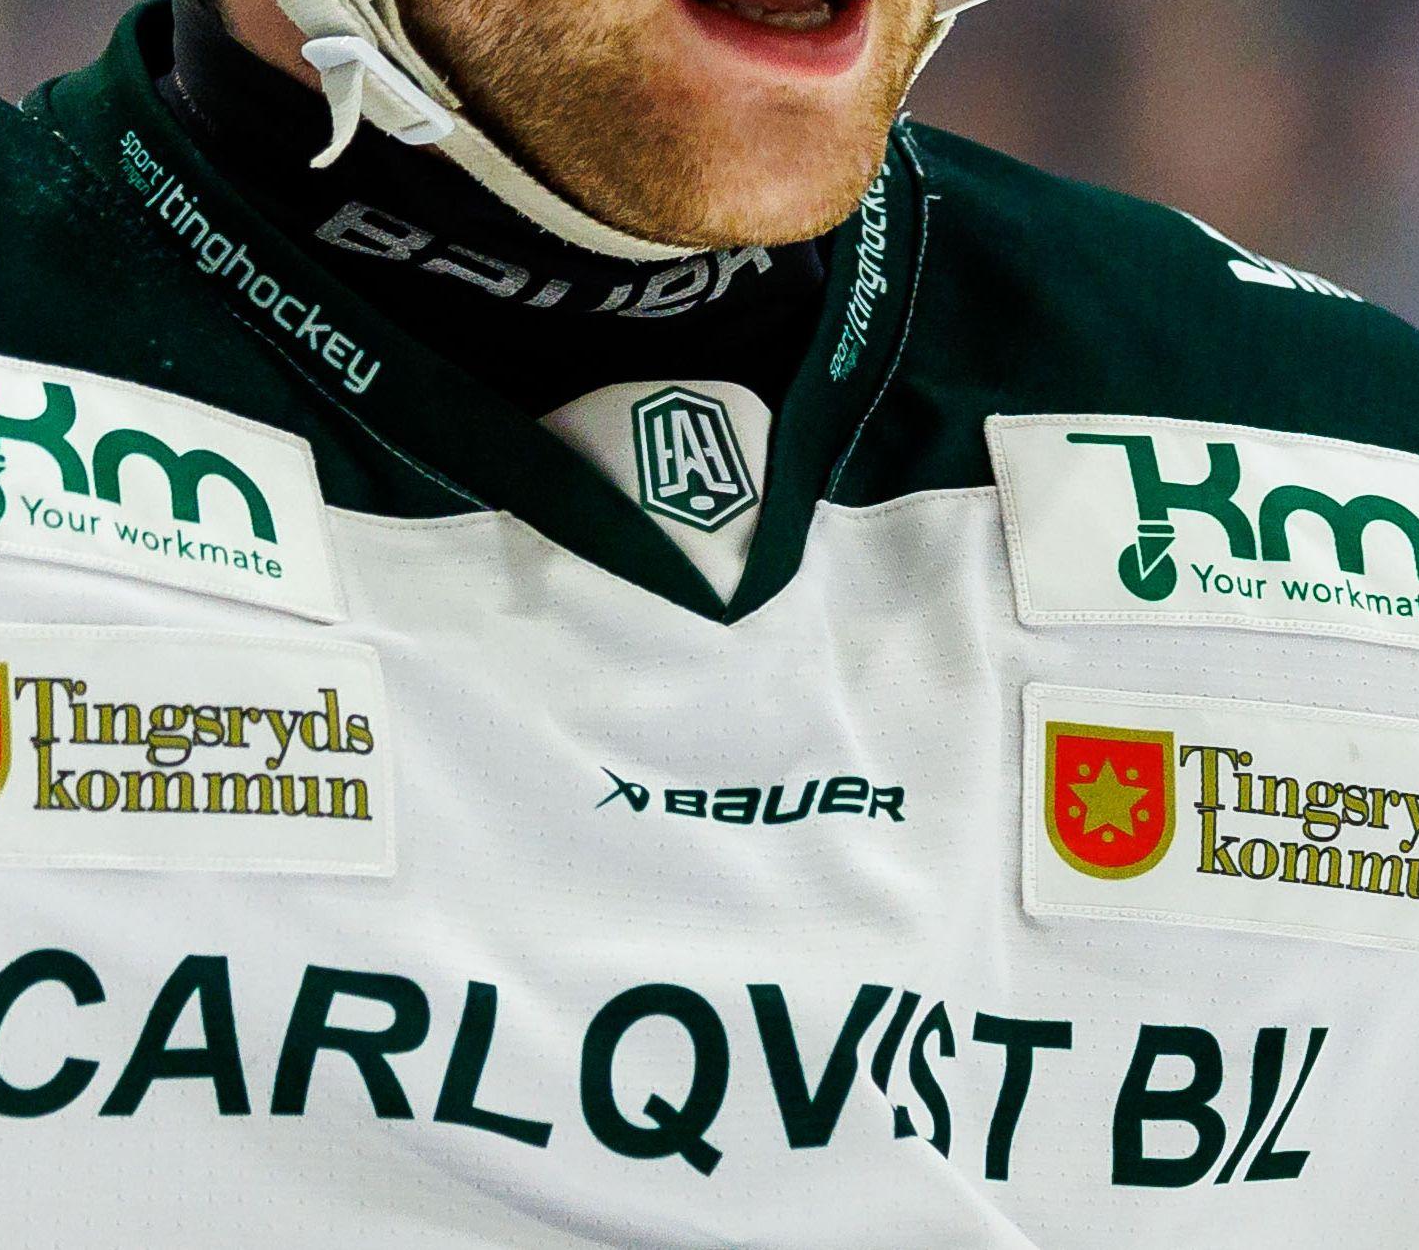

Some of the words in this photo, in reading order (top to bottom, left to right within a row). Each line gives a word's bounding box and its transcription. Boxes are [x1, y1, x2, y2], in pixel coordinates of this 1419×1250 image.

[19, 495, 102, 536] Your
[114, 520, 283, 580] workmate
[1190, 562, 1267, 601] Your
[14, 676, 376, 771] Tingsryds
[30, 736, 374, 821] kommun
[663, 775, 907, 825] BAUER
[1111, 1023, 1330, 1189] BIL
